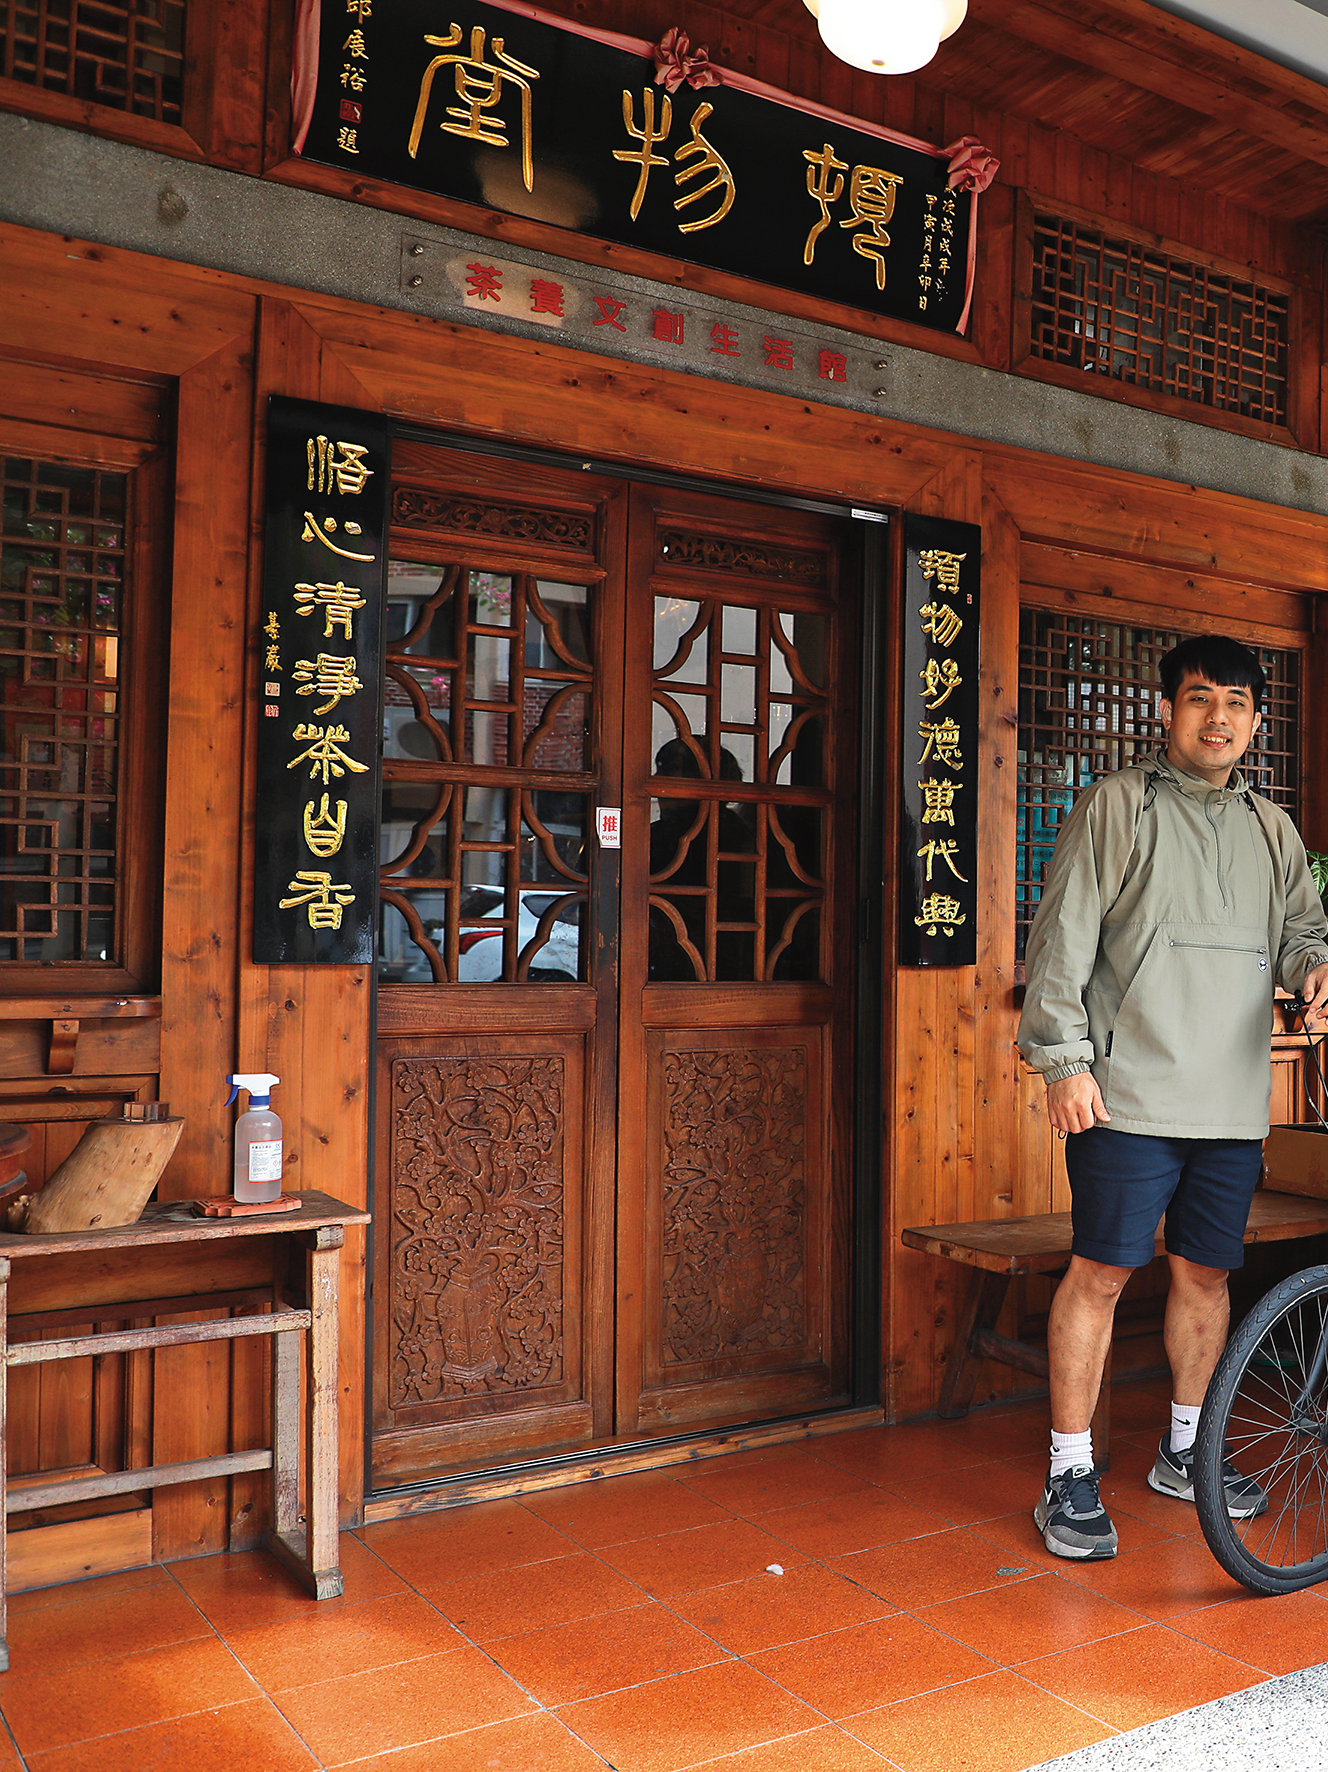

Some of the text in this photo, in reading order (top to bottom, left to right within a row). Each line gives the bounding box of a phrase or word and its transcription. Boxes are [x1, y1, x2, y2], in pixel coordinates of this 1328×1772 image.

[466, 263, 848, 383] 茶養文創生活館
[602, 815, 617, 832] 推
